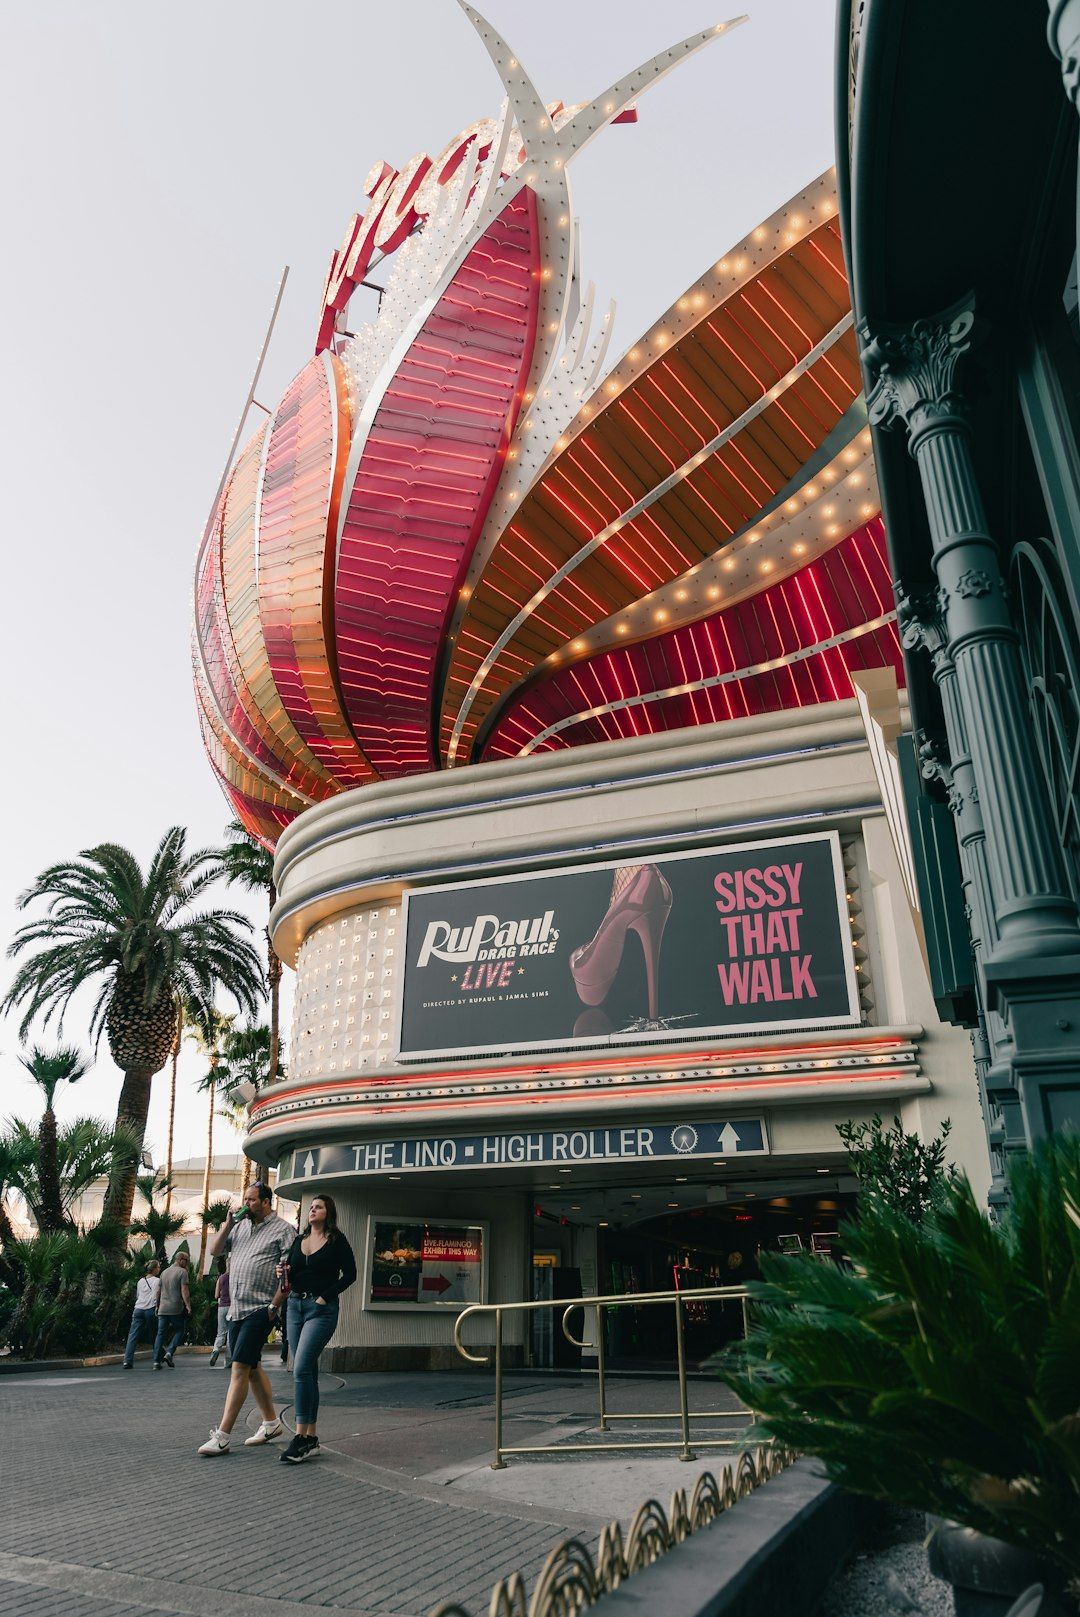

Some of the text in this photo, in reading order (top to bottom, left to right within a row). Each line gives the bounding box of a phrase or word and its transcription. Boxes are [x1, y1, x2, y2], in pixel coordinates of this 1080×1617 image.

[714, 863, 802, 913] SISSY
[416, 910, 560, 967] RuPaul's
[478, 942, 557, 961] DRAG RACE
[720, 908, 803, 957] THAT
[460, 960, 515, 991] LIVE
[717, 955, 818, 1006] WALK
[423, 1000, 455, 1008] DIRECTED
[469, 996, 496, 1004] RUPAUL
[505, 993, 529, 1001] JAMAL
[531, 990, 549, 998] SIMS
[352, 1128, 654, 1171] THE LINQ HIGH ROLLER
[423, 1247, 447, 1255] EXHIBIT
[448, 1248, 462, 1256] THIS
[463, 1248, 477, 1256] WAY
